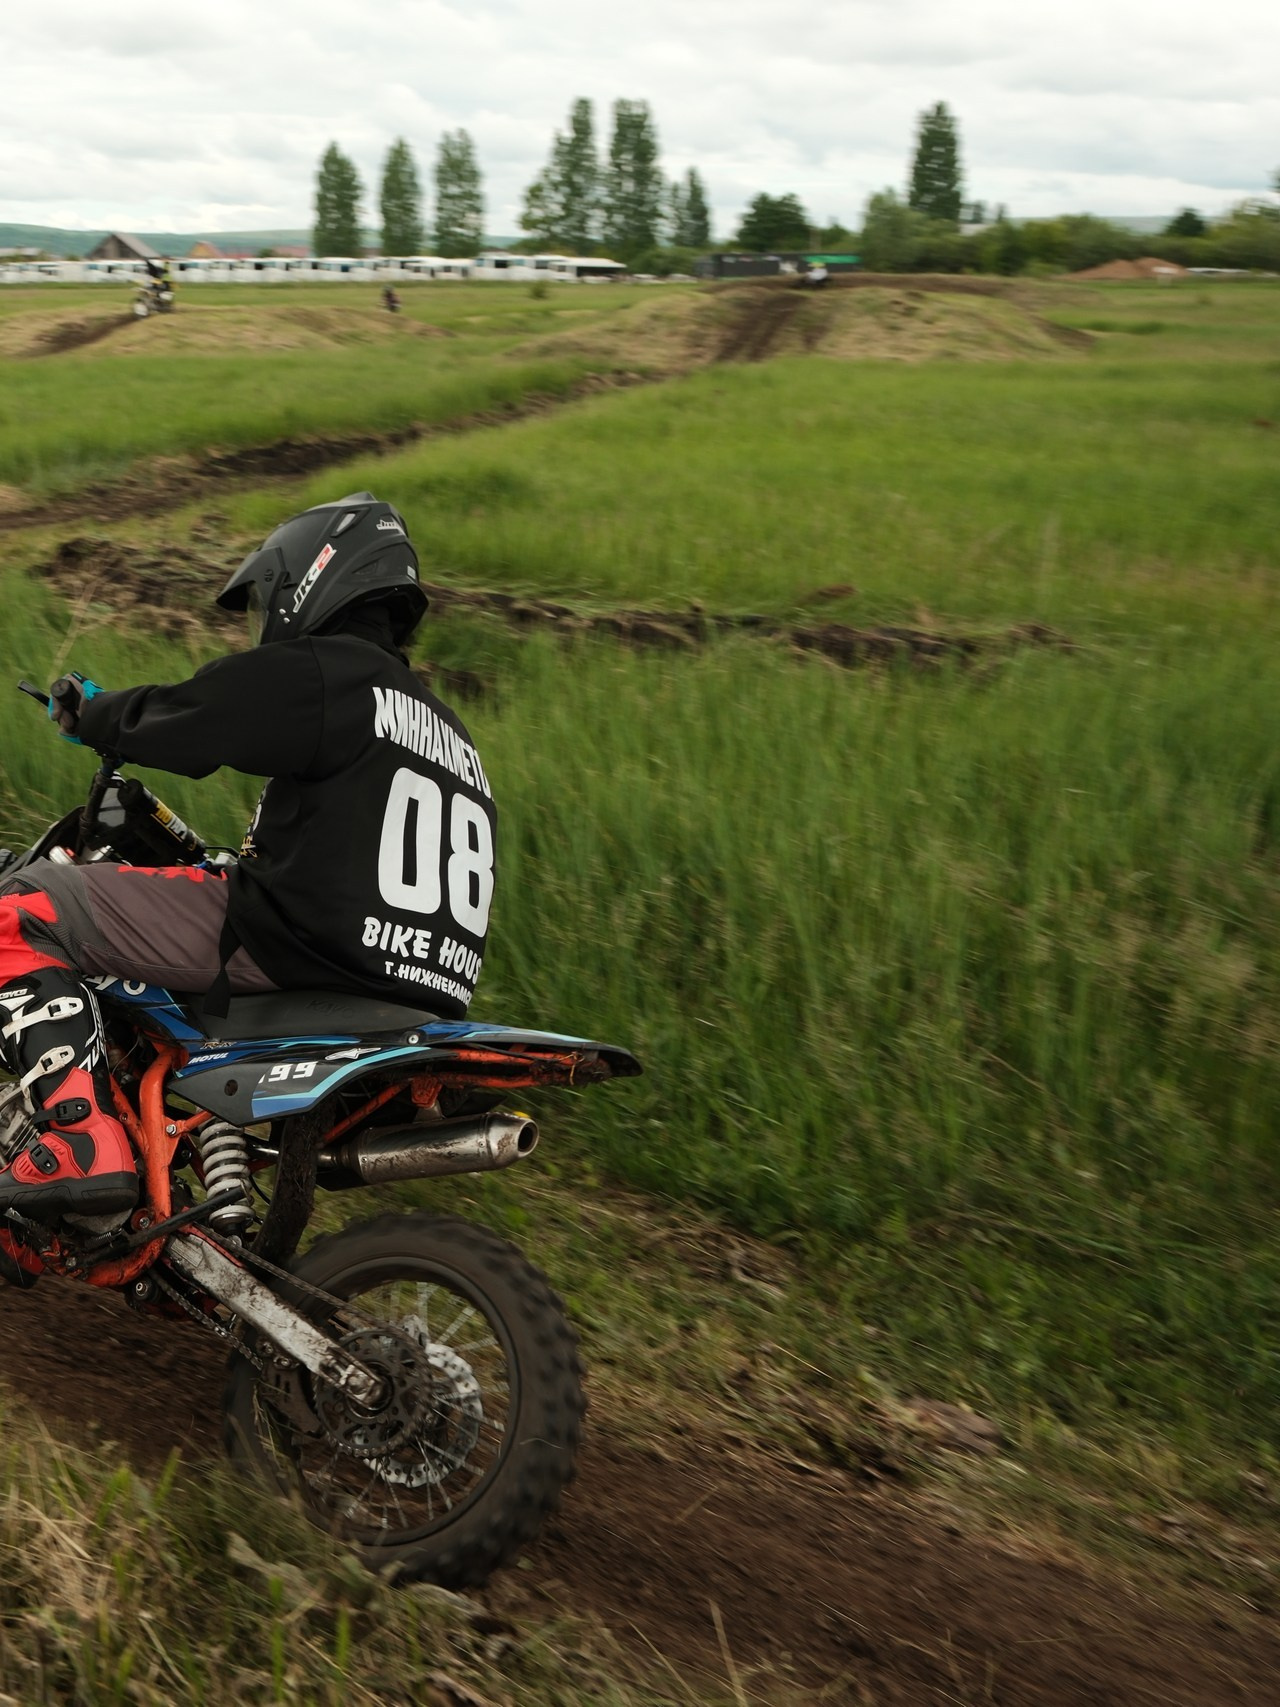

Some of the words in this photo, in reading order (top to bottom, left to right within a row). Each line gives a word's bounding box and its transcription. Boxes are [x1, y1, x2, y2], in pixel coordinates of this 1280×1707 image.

[372, 686, 494, 802] МИННАХМЕТО
[377, 767, 495, 938] 08
[361, 916, 433, 959] BIKE
[187, 1052, 229, 1065] MOTUL
[267, 1060, 319, 1083] 99
